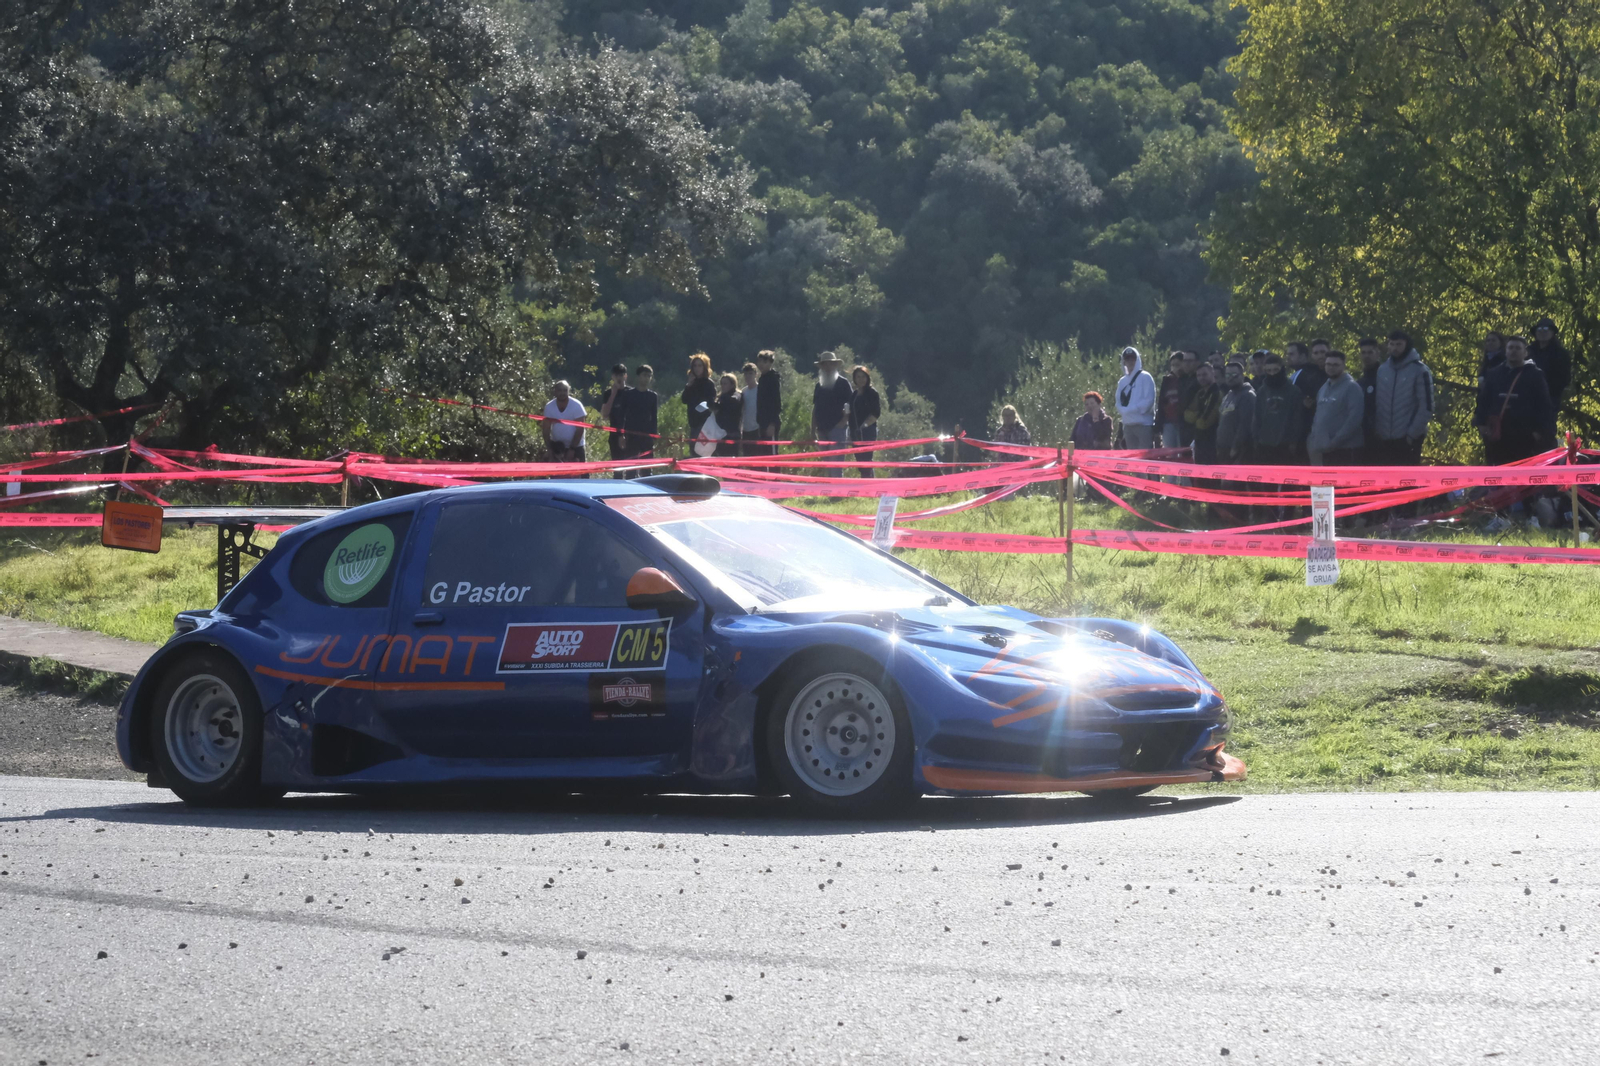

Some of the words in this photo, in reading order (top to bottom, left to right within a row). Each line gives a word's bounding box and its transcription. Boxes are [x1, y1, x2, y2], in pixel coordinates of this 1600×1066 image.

[335, 541, 387, 567] Retlife
[1317, 564, 1337, 572] AVISA
[1313, 575, 1332, 583] GRUA
[429, 581, 449, 604] G
[452, 581, 532, 603] Pastor
[535, 630, 584, 645] AUTO
[616, 628, 650, 662] CM
[651, 626, 665, 661] 5
[279, 634, 497, 676] JUMAT
[531, 644, 581, 659] SPORT
